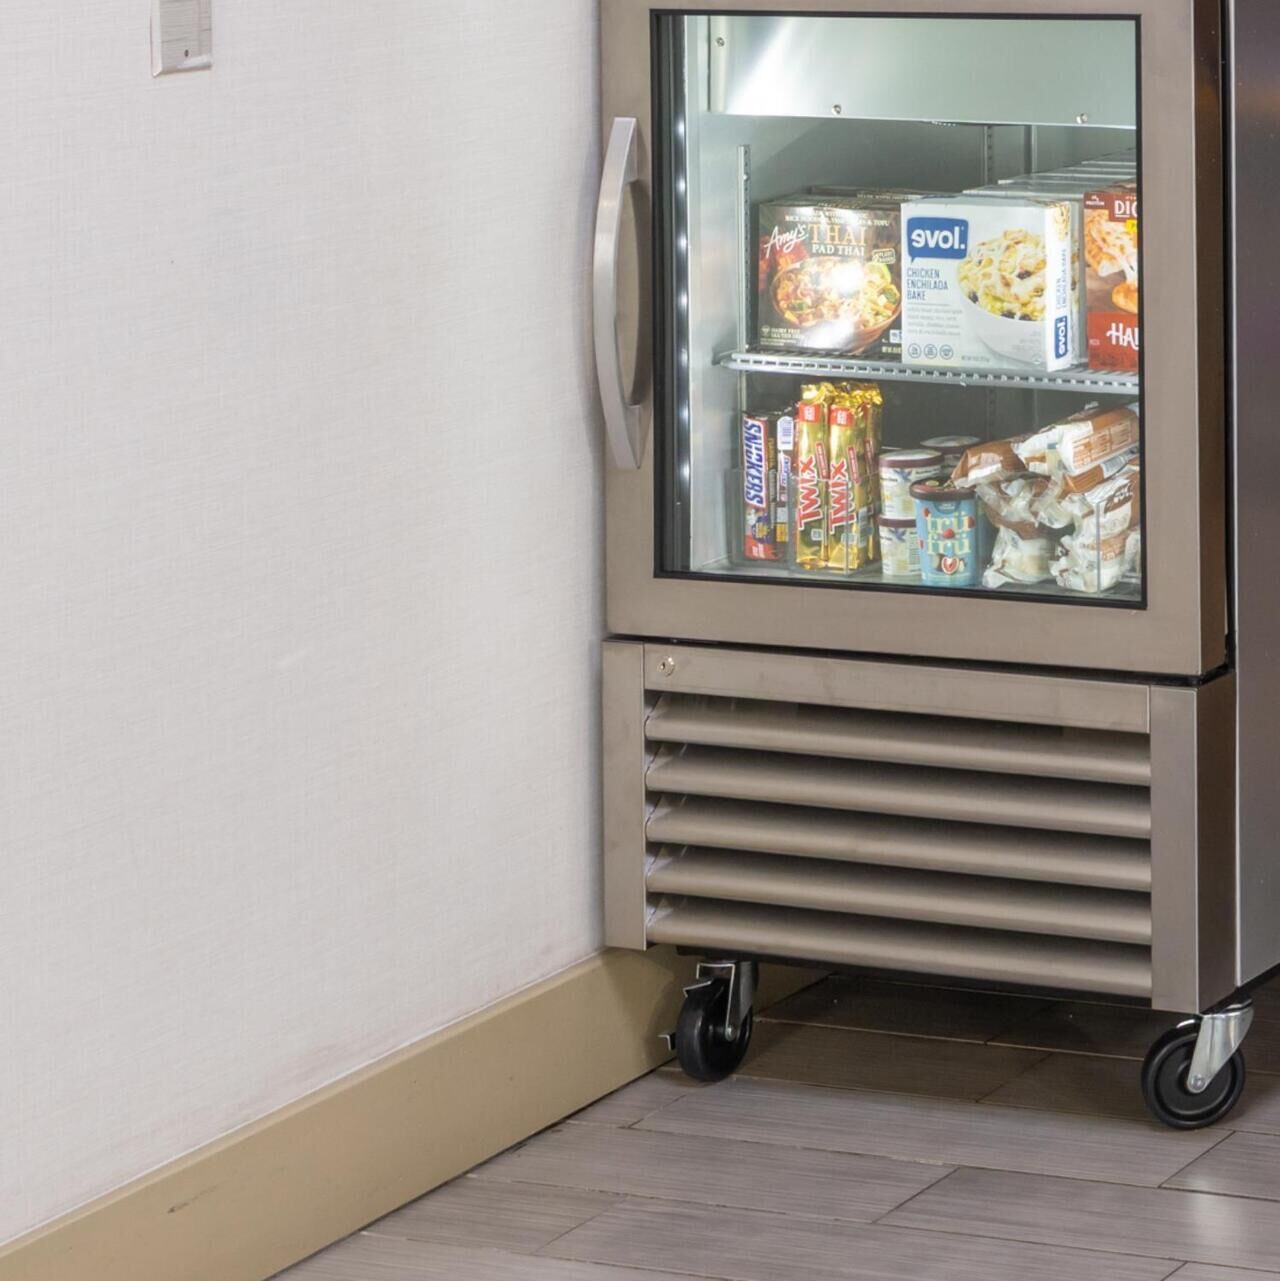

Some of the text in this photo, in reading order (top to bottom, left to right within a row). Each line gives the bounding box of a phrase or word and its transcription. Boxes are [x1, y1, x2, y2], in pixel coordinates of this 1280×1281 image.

[808, 223, 866, 246] THAI
[764, 224, 809, 258] Amy's
[812, 244, 864, 256] PAD THAI
[907, 267, 940, 279] CHICKEN
[907, 279, 949, 290] ENCHILADA
[906, 290, 926, 301] BAKE
[744, 420, 765, 507] SNICKERS
